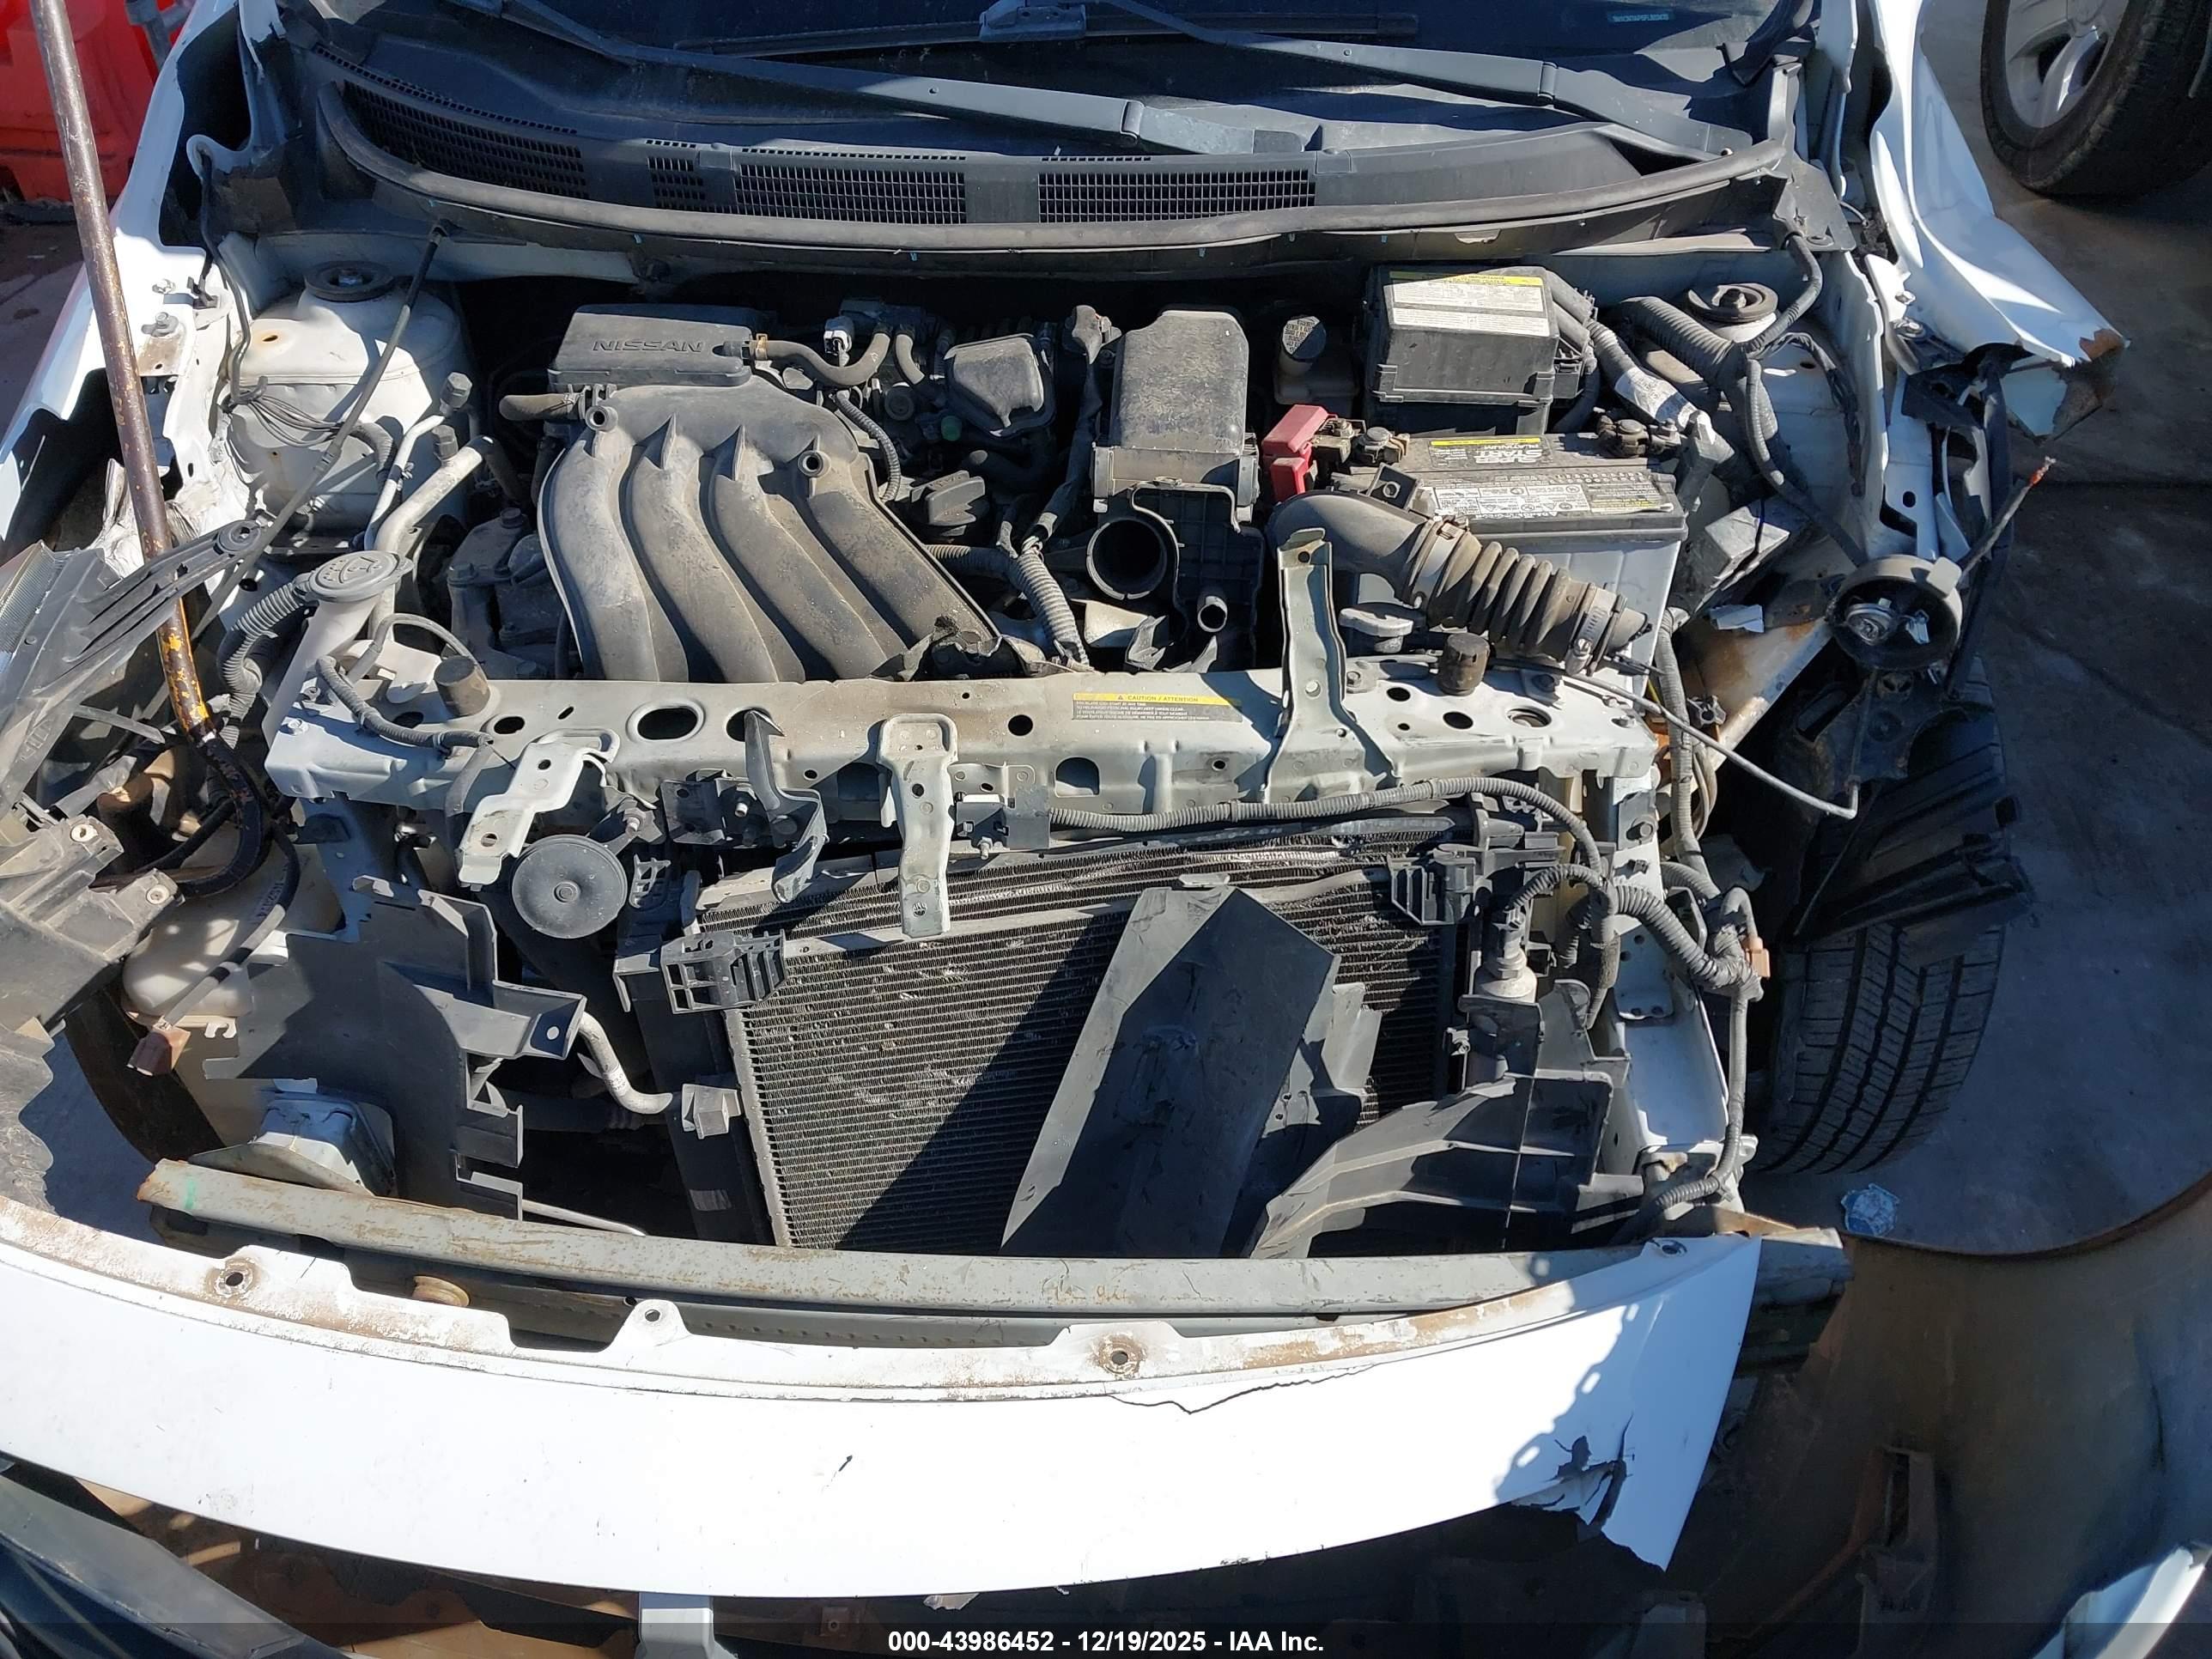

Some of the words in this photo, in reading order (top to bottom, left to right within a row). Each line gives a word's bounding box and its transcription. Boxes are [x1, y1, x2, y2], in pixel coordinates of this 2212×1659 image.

[592, 340, 704, 353] NISSAN
[1475, 448, 1543, 458] START
[1474, 455, 1536, 464] SUPER
